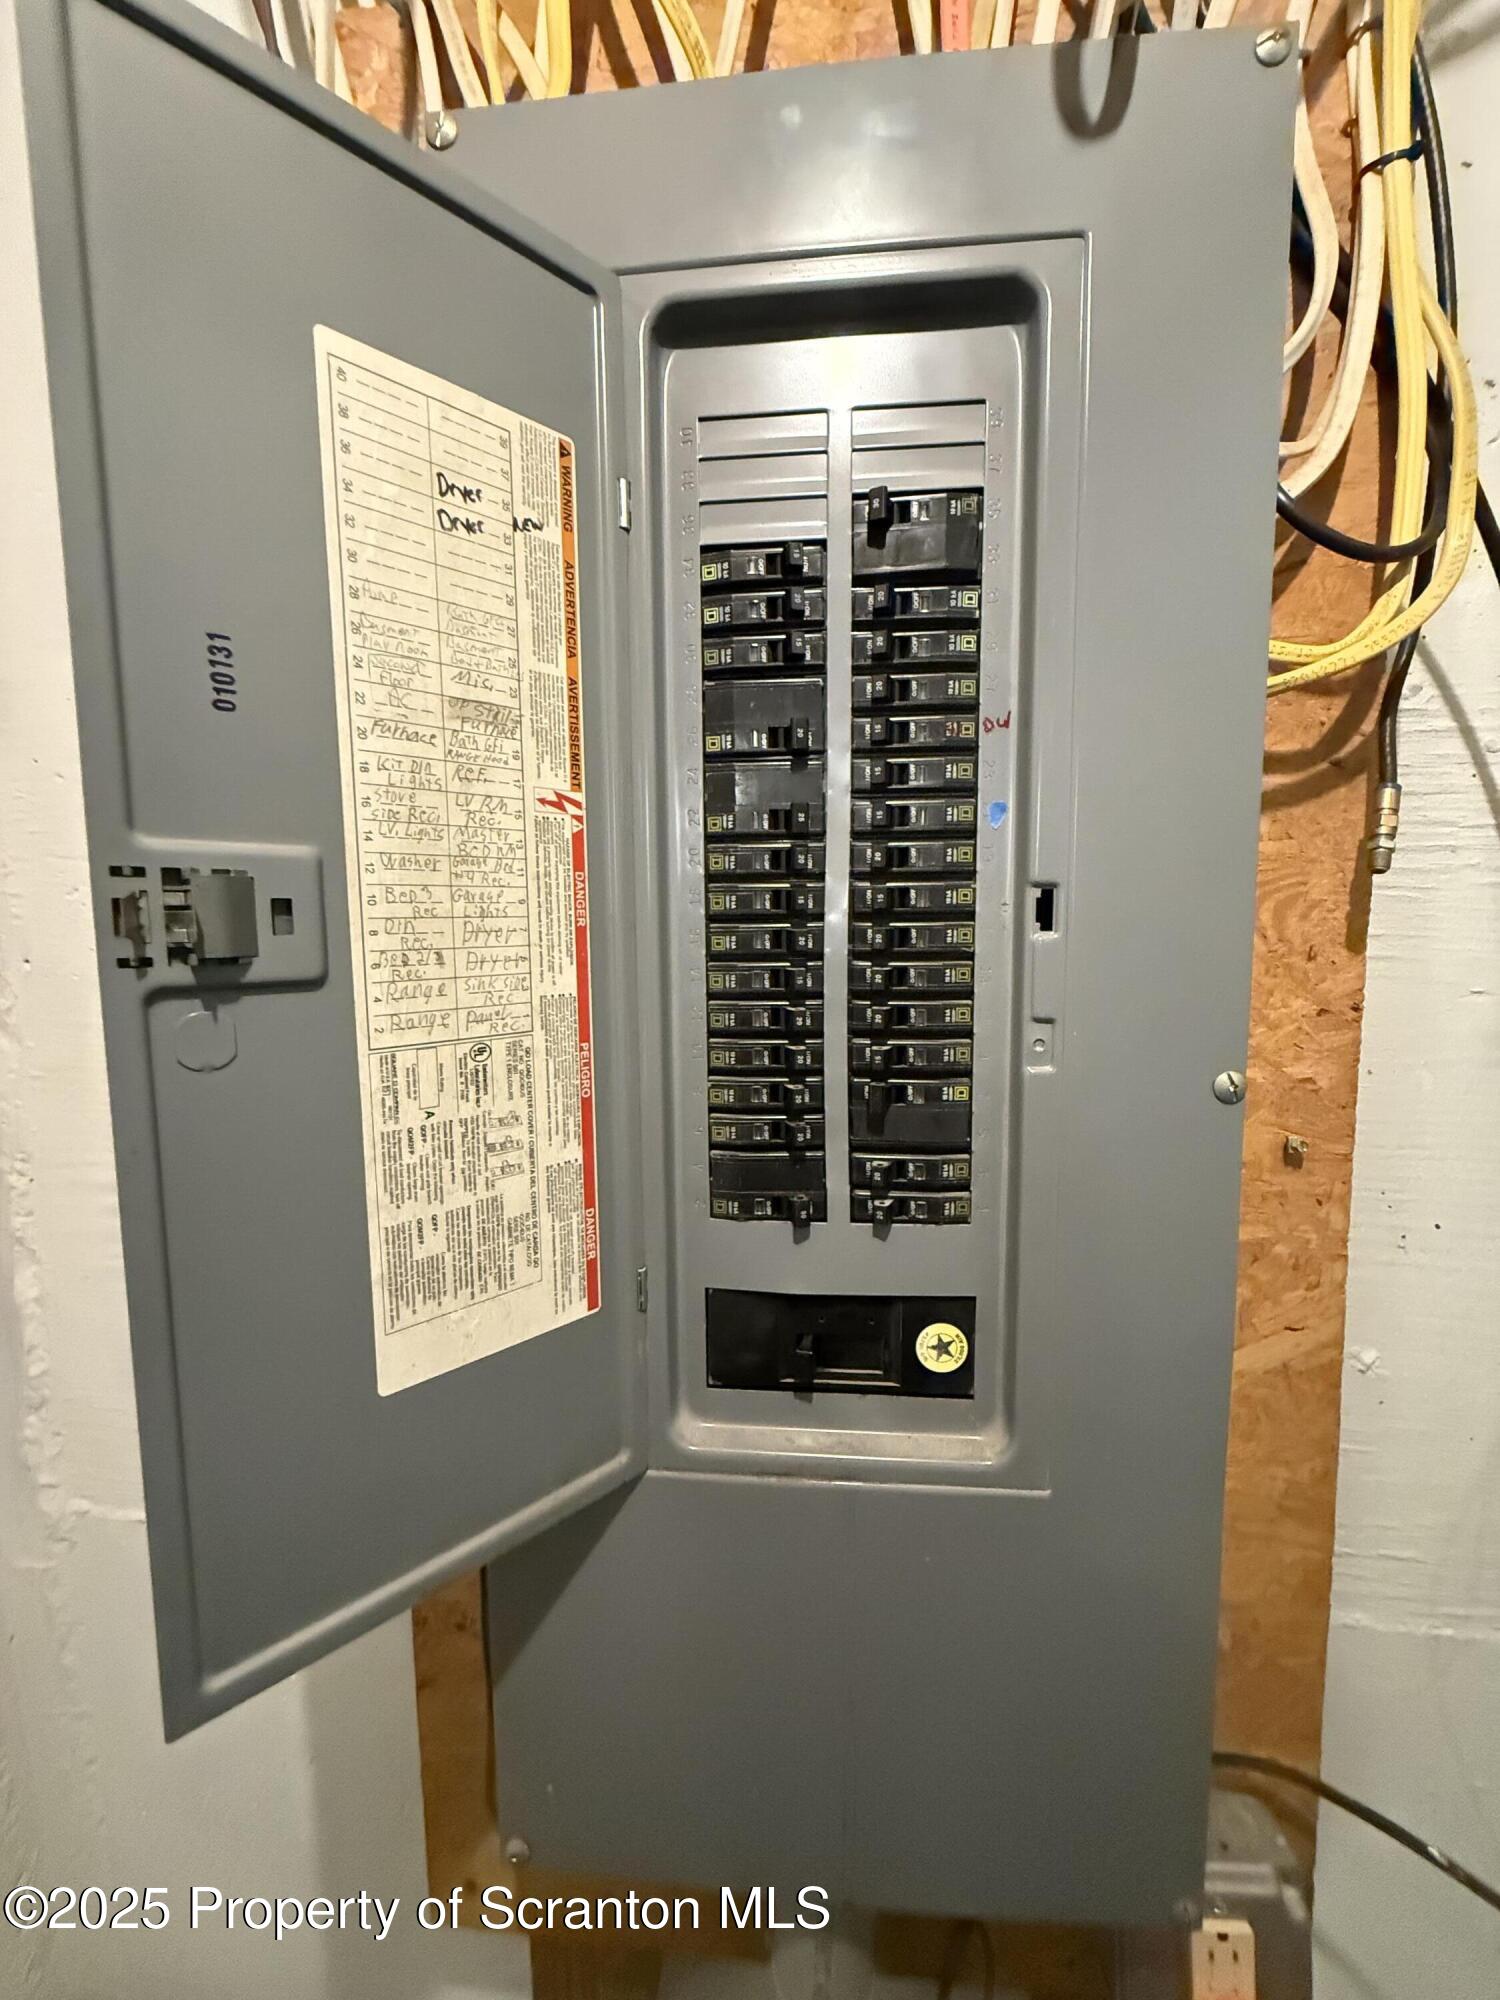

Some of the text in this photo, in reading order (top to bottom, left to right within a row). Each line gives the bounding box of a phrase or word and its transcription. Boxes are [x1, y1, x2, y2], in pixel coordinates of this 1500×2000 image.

[336, 366, 347, 381] 40
[338, 402, 349, 420] 38
[340, 439, 351, 455] 36
[499, 434, 508, 449] 39
[501, 468, 510, 482] 37
[343, 478, 354, 493] 34
[436, 472, 482, 504] Dryer
[560, 463, 572, 533] WARNING
[502, 499, 511, 512] 35
[344, 513, 356, 529] 32
[437, 508, 484, 536] Dryer
[503, 533, 512, 546] 33
[346, 549, 357, 563] 30
[504, 563, 513, 575] 31
[349, 585, 359, 600] 28
[506, 593, 514, 606] 29
[877, 591, 885, 601] 20
[563, 559, 576, 660] ADVERTENCIA
[351, 620, 362, 635] 26
[507, 626, 515, 638] 27
[877, 636, 884, 647] 20
[353, 655, 363, 669] 24
[508, 656, 517, 669] 25
[205, 632, 237, 712] 010131
[509, 686, 518, 699] 23
[876, 681, 883, 691] 20
[354, 691, 366, 705] 22
[357, 726, 368, 740] 20
[371, 720, 437, 747] Furnace
[567, 675, 581, 789] AVERTISSEMENT
[512, 750, 520, 760] 19
[359, 761, 370, 773] 18
[513, 779, 521, 789] 17
[361, 796, 371, 807] 16
[514, 810, 523, 820] 15
[363, 830, 373, 841] 14
[516, 840, 524, 849] 13
[365, 862, 375, 874] 12
[380, 852, 441, 872] Washer
[516, 868, 525, 877] 11
[367, 894, 377, 906] 10
[574, 871, 585, 927] DANGER
[368, 929, 379, 937] 8
[524, 1058, 532, 1081] LOAD
[579, 1041, 591, 1099] PELIGRO
[525, 1080, 533, 1109] CENTER
[585, 1206, 596, 1261] DANGER
